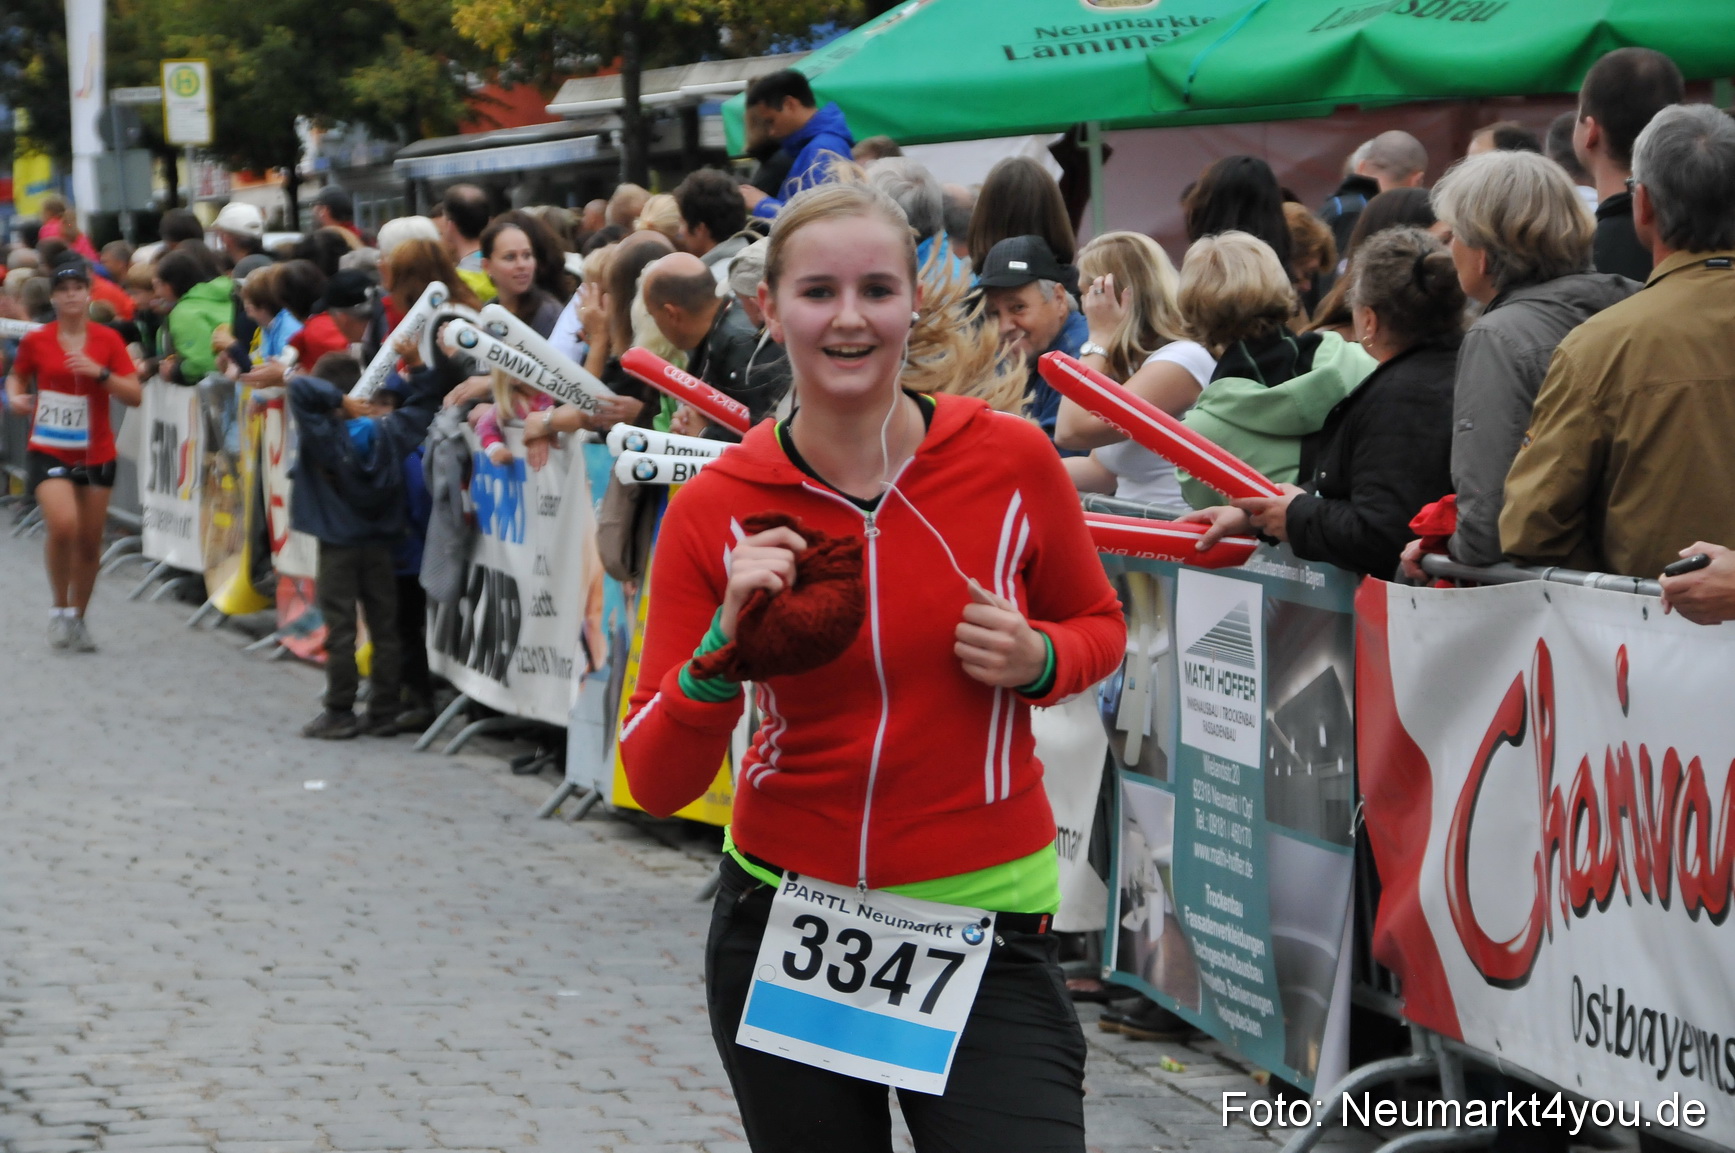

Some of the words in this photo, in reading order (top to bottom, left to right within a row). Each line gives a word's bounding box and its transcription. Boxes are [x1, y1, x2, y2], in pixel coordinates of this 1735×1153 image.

[486, 343, 537, 378] BMW
[39, 404, 84, 427] 2187
[672, 462, 704, 482] BM
[1184, 660, 1215, 693] MATHI
[1216, 669, 1257, 703] HOFFER
[782, 882, 850, 914] PARTL
[856, 904, 953, 939] Neumarkt
[1205, 883, 1244, 918] Trockenbau
[781, 914, 966, 1015] 3347
